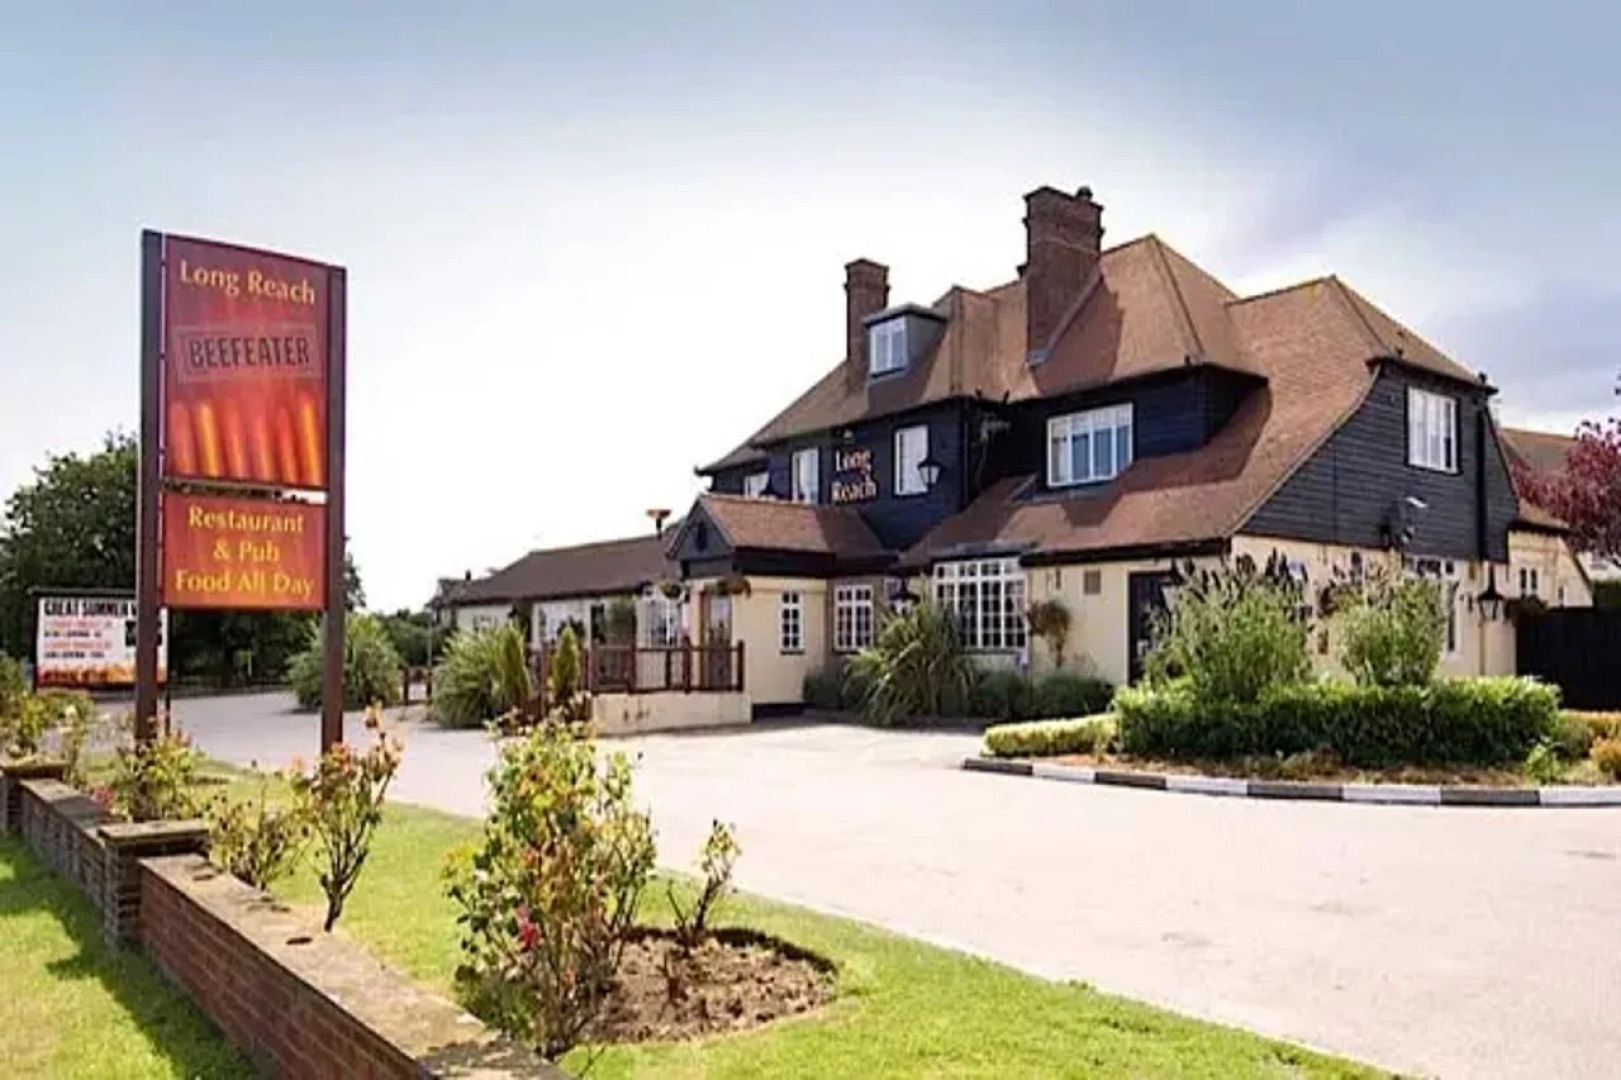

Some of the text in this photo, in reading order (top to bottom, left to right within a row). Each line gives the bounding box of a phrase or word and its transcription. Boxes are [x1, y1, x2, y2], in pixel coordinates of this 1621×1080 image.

[180, 260, 316, 305] Long Reach
[189, 337, 309, 368] BEEFEATER
[189, 503, 305, 533] Restaurant
[213, 539, 281, 563] & Pub
[175, 569, 314, 600] Food All Day
